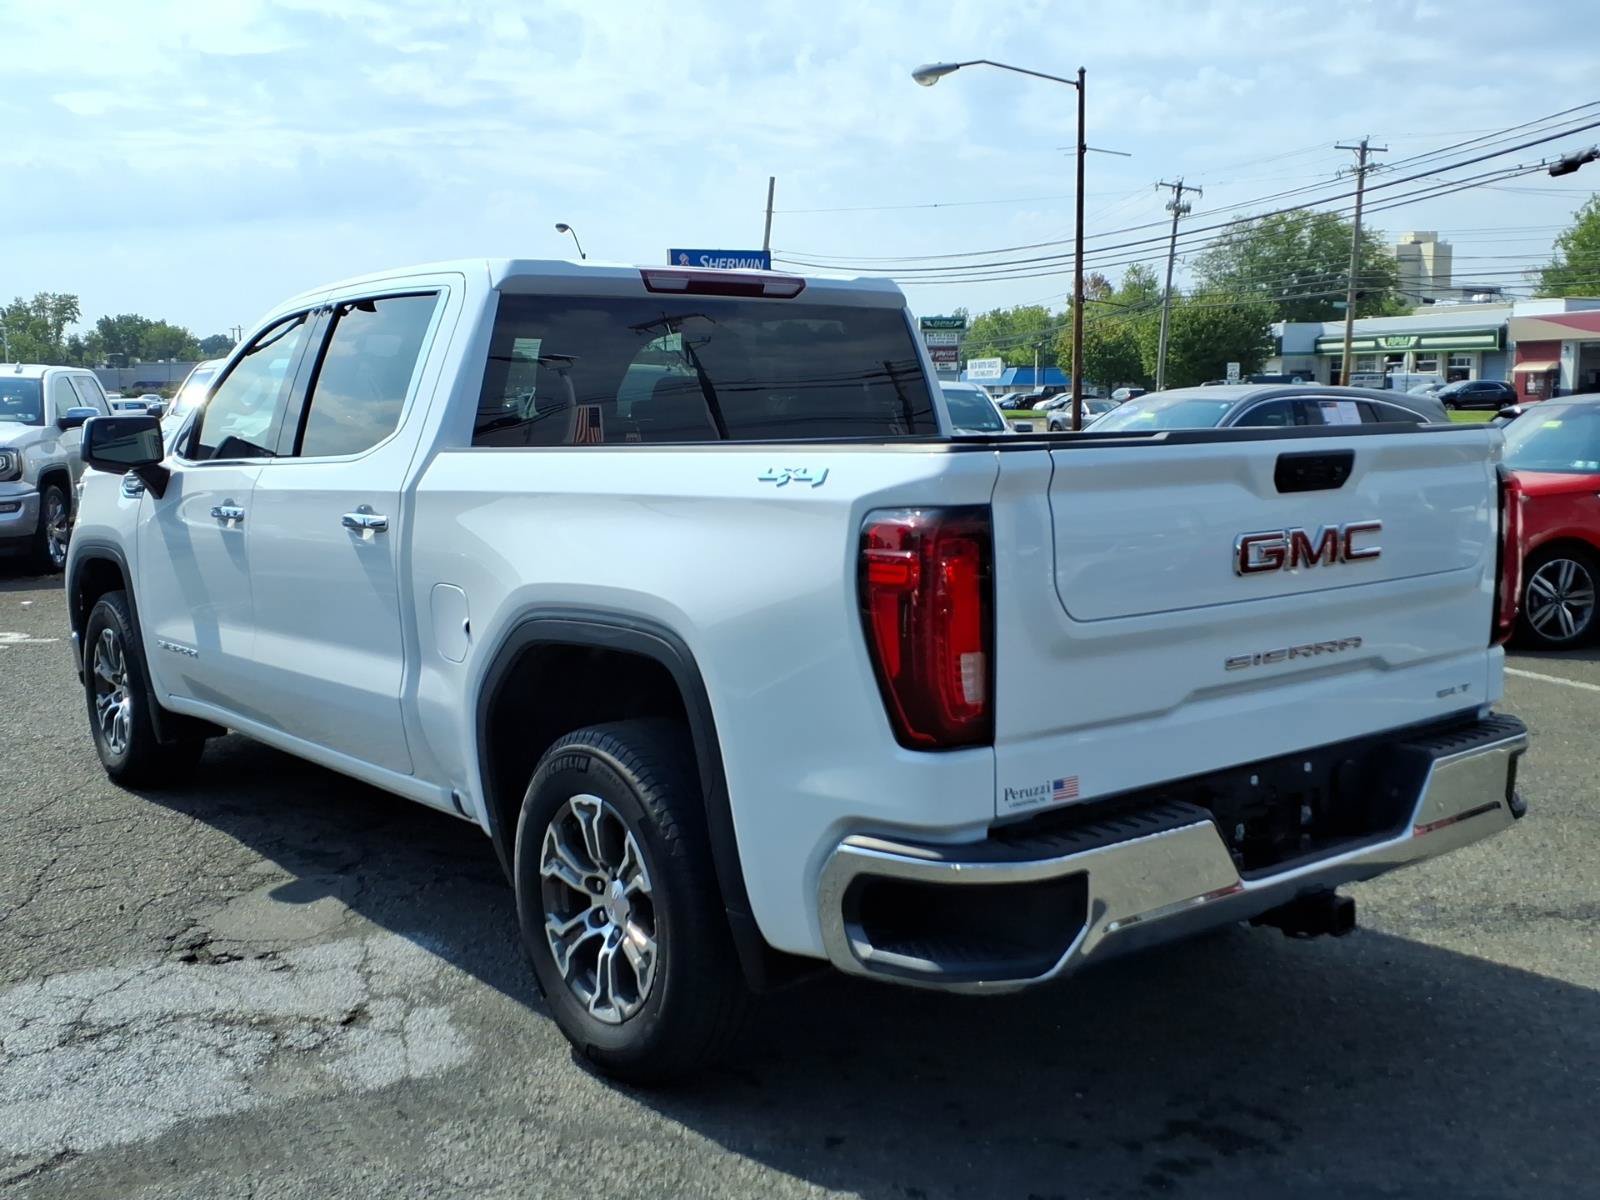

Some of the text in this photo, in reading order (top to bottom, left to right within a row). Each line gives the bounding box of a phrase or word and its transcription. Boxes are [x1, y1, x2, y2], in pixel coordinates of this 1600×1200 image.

[700, 255, 765, 270] SHERWIN
[1233, 519, 1383, 577] GMC
[1225, 636, 1363, 671] SIERRA
[1004, 780, 1051, 802] Peruzzi
